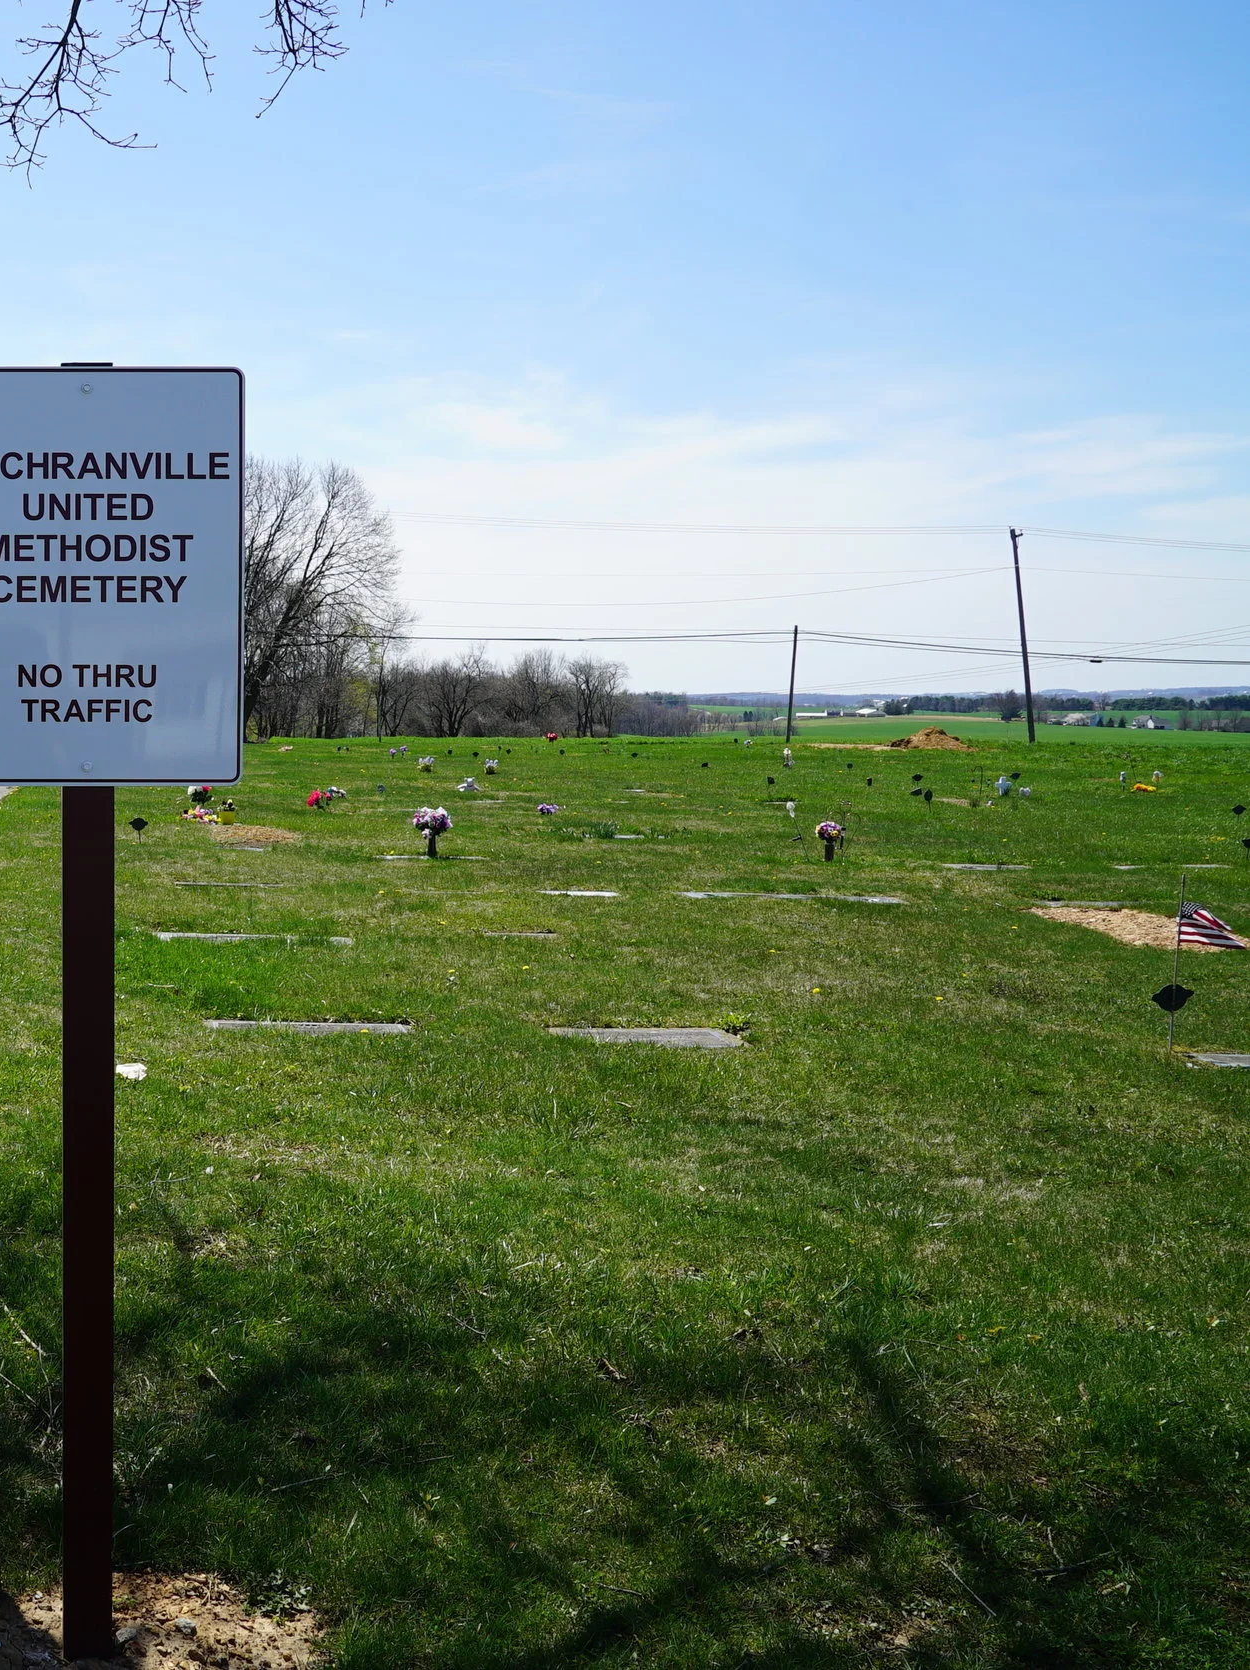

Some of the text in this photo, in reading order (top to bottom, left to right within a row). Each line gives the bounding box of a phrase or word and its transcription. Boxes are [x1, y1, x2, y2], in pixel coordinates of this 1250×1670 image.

[23, 494, 153, 521] UNITED
[18, 664, 157, 688] NO THRU
[21, 699, 153, 723] TRAFFIC
